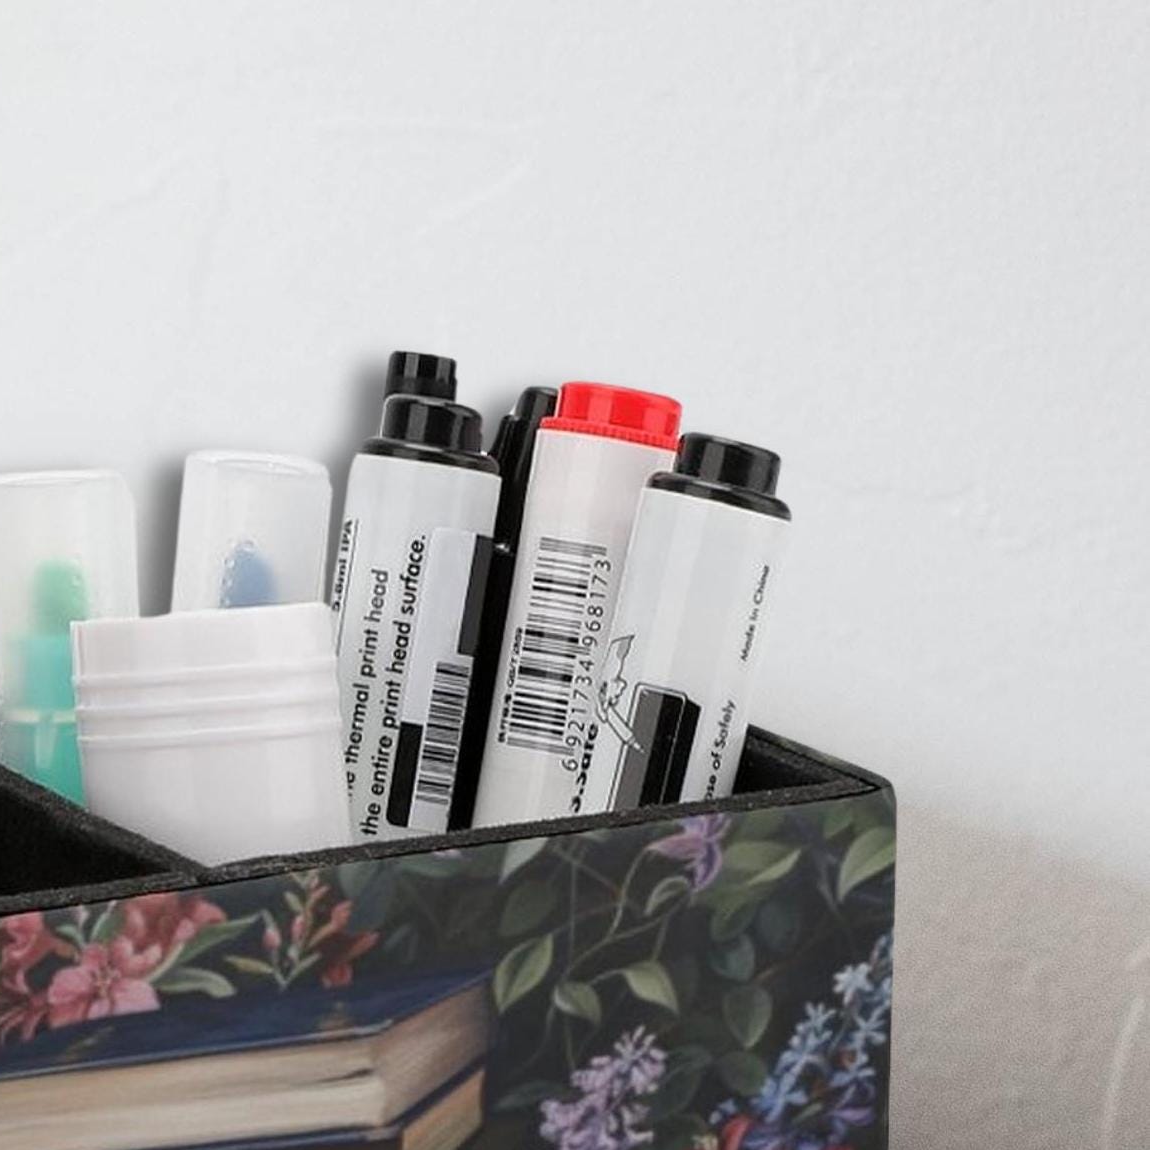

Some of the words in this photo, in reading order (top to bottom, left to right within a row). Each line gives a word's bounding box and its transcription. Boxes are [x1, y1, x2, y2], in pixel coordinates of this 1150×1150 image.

[363, 568, 388, 622] head
[399, 535, 426, 615] surface.
[741, 624, 756, 661] Made
[753, 565, 770, 604] China
[358, 628, 377, 678] print
[384, 619, 411, 674] head
[343, 683, 370, 763] thermal
[380, 680, 402, 729] print
[371, 735, 392, 795] entire
[710, 752, 722, 772] of
[359, 802, 381, 835] the
